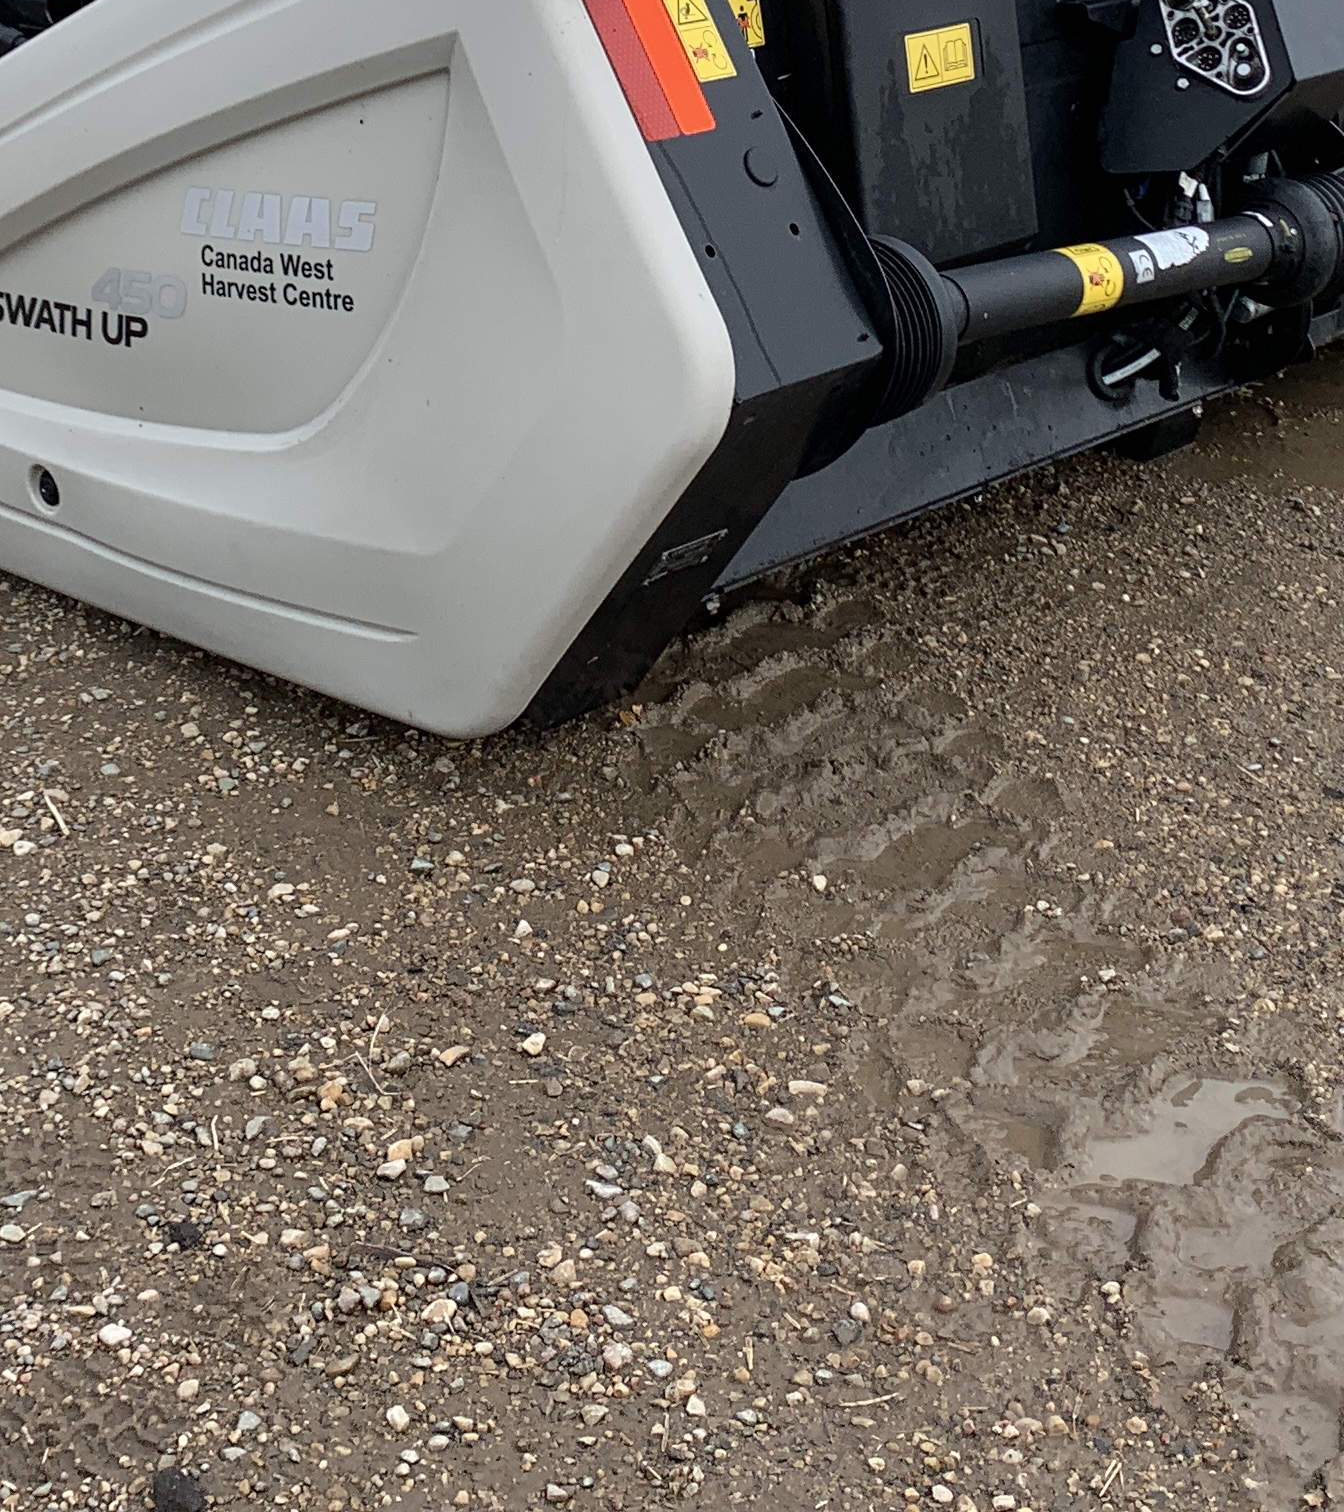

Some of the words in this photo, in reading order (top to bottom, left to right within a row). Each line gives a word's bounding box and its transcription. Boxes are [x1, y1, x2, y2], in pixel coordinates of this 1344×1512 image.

[180, 187, 377, 252] CLAAS
[201, 244, 274, 274] Canada
[280, 253, 334, 281] West
[91, 267, 188, 320] 450
[201, 272, 277, 304] Harvest
[283, 283, 354, 312] Centre
[101, 311, 148, 347] UP
